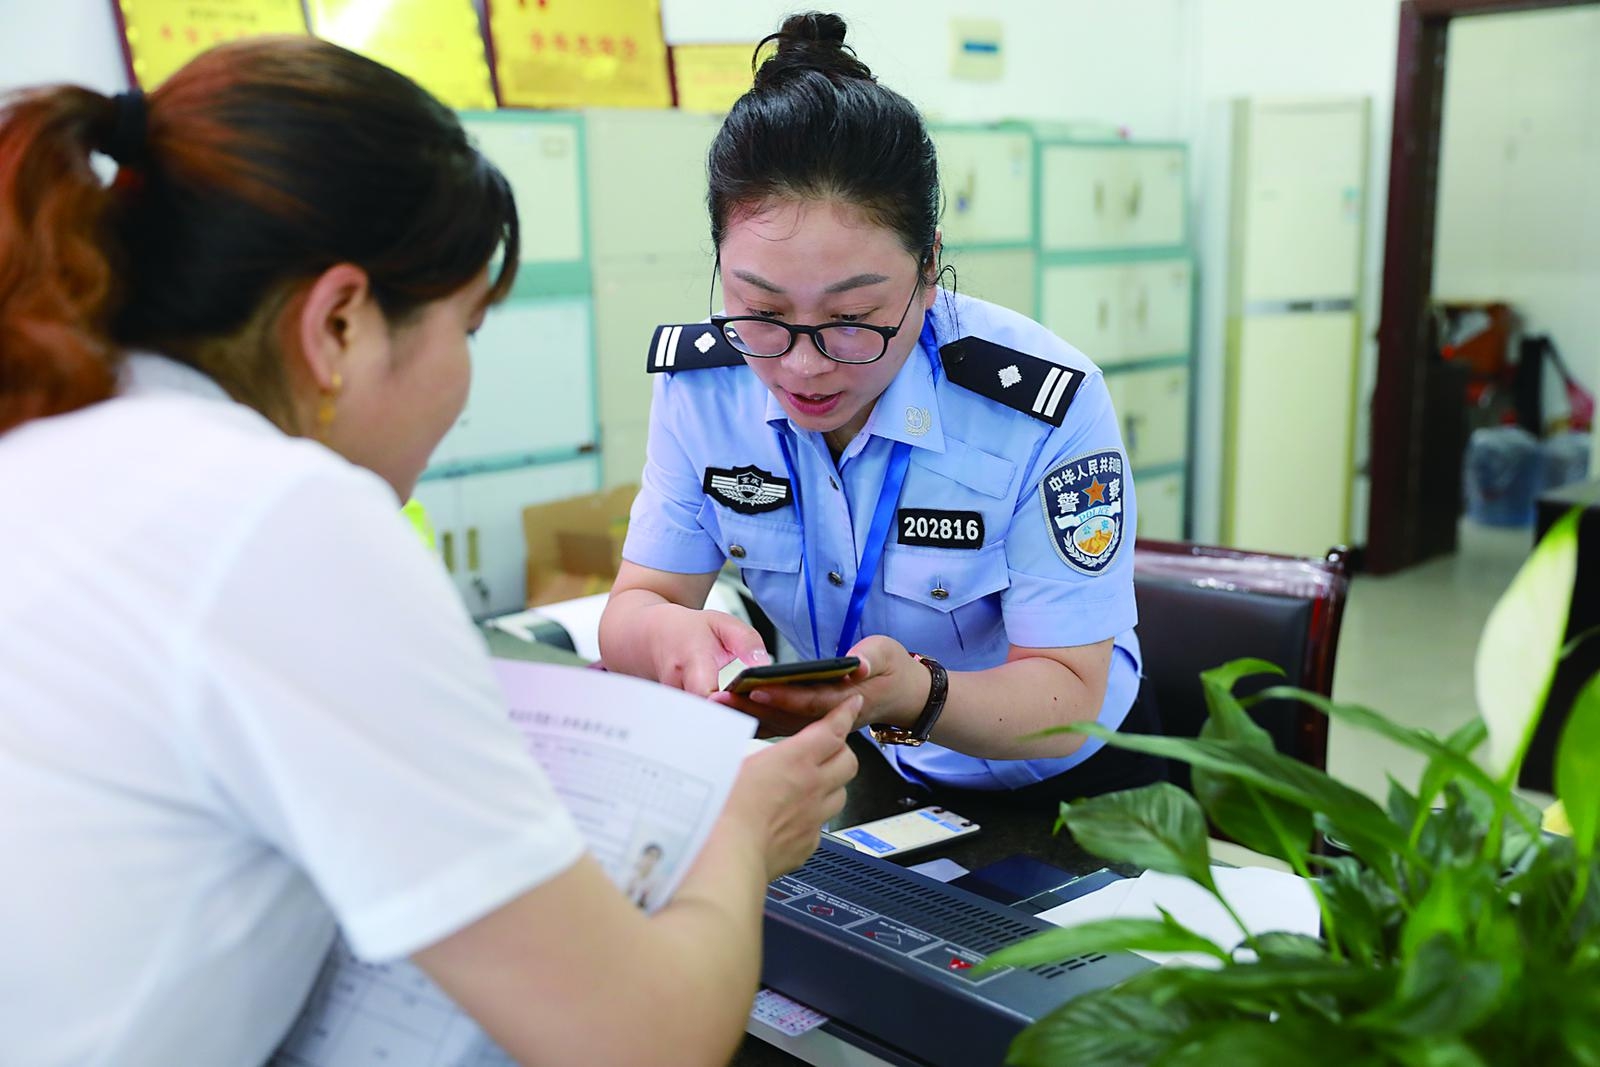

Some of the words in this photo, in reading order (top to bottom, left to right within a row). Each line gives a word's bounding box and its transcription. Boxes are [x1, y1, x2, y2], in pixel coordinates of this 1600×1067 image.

[1078, 506, 1111, 523] POLICE
[904, 517, 979, 540] 202816
[1082, 519, 1110, 535] 公安
